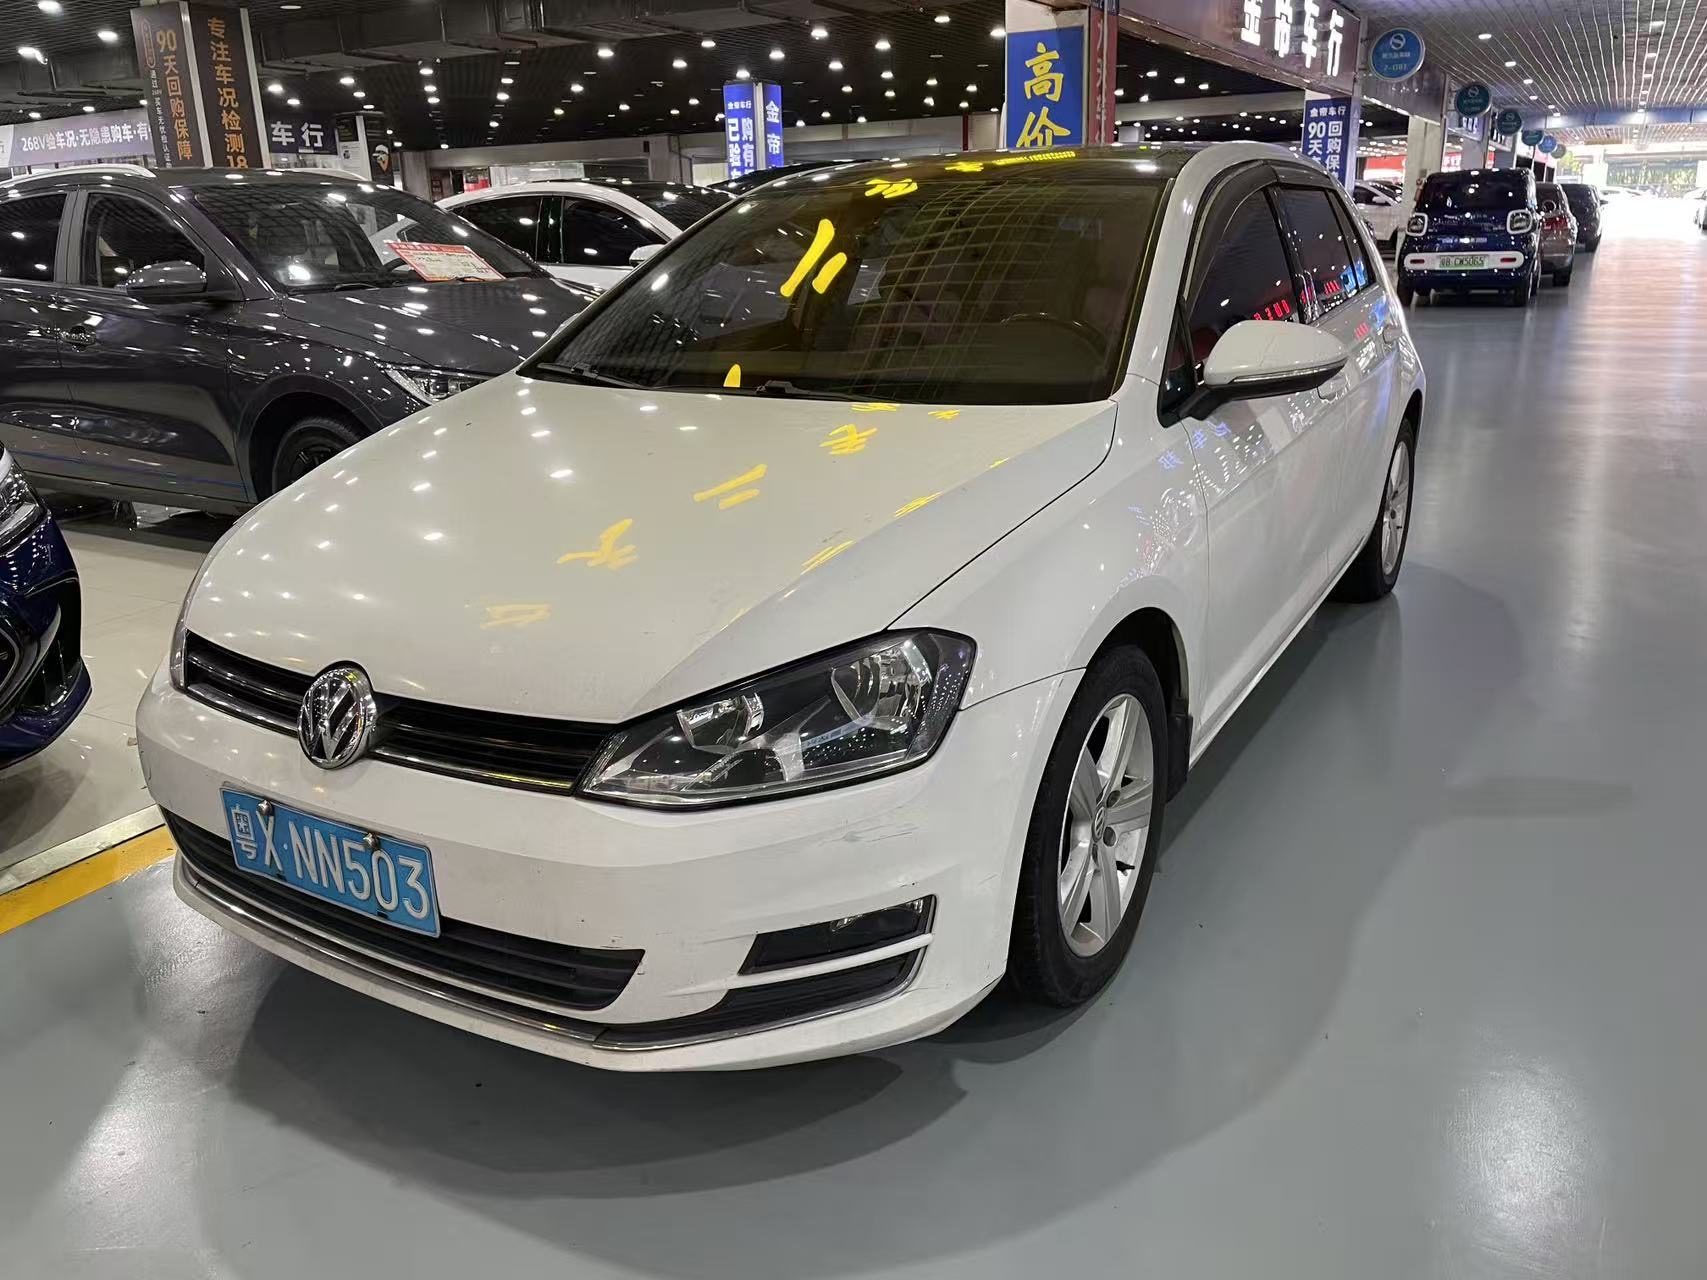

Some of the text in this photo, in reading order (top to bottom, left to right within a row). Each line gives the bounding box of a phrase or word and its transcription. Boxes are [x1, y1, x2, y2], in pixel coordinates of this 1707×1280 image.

[156, 28, 193, 161] 90天回购保障
[1015, 42, 1071, 148] 高价
[1309, 105, 1346, 118] 金帝车行
[21, 122, 152, 152] 268V验车况·无隐患购车·有
[270, 120, 324, 148] 车行
[741, 117, 755, 175] 购有
[765, 100, 782, 169] 金帝
